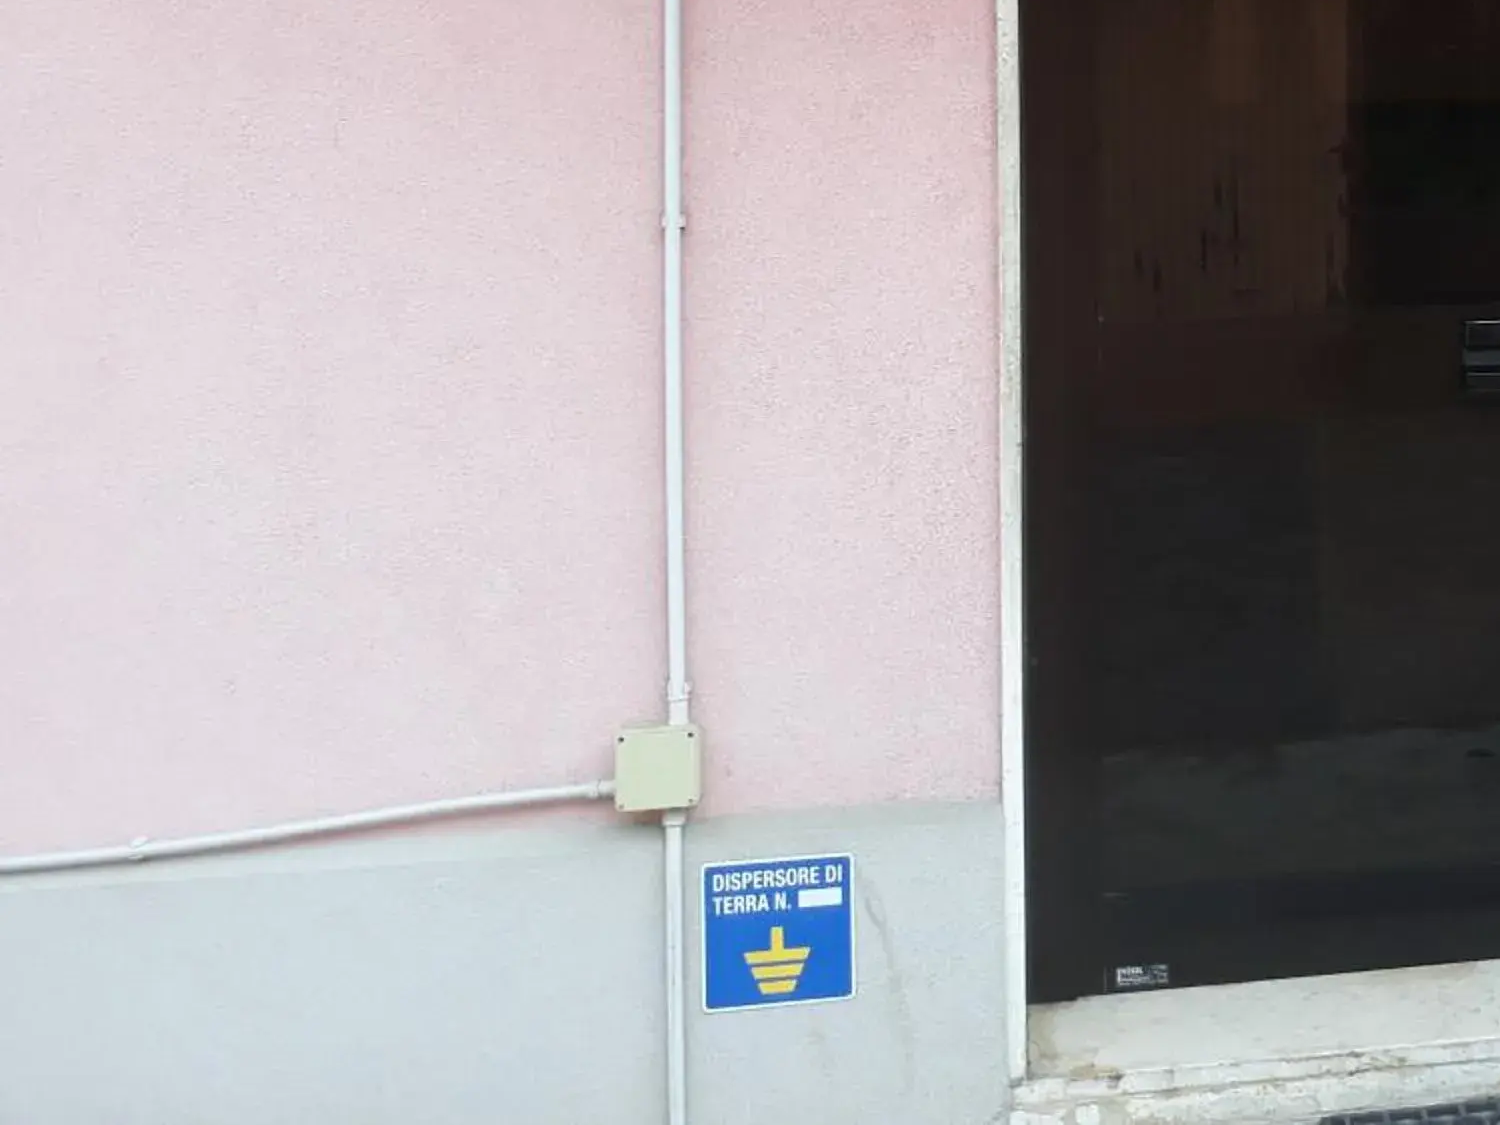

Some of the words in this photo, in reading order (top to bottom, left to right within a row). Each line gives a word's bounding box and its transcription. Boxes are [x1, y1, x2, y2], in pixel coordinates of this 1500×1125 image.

[713, 866, 820, 892] DISPERSORE
[825, 864, 843, 883] DI
[712, 893, 770, 915] TERRA
[774, 891, 792, 911] N.
